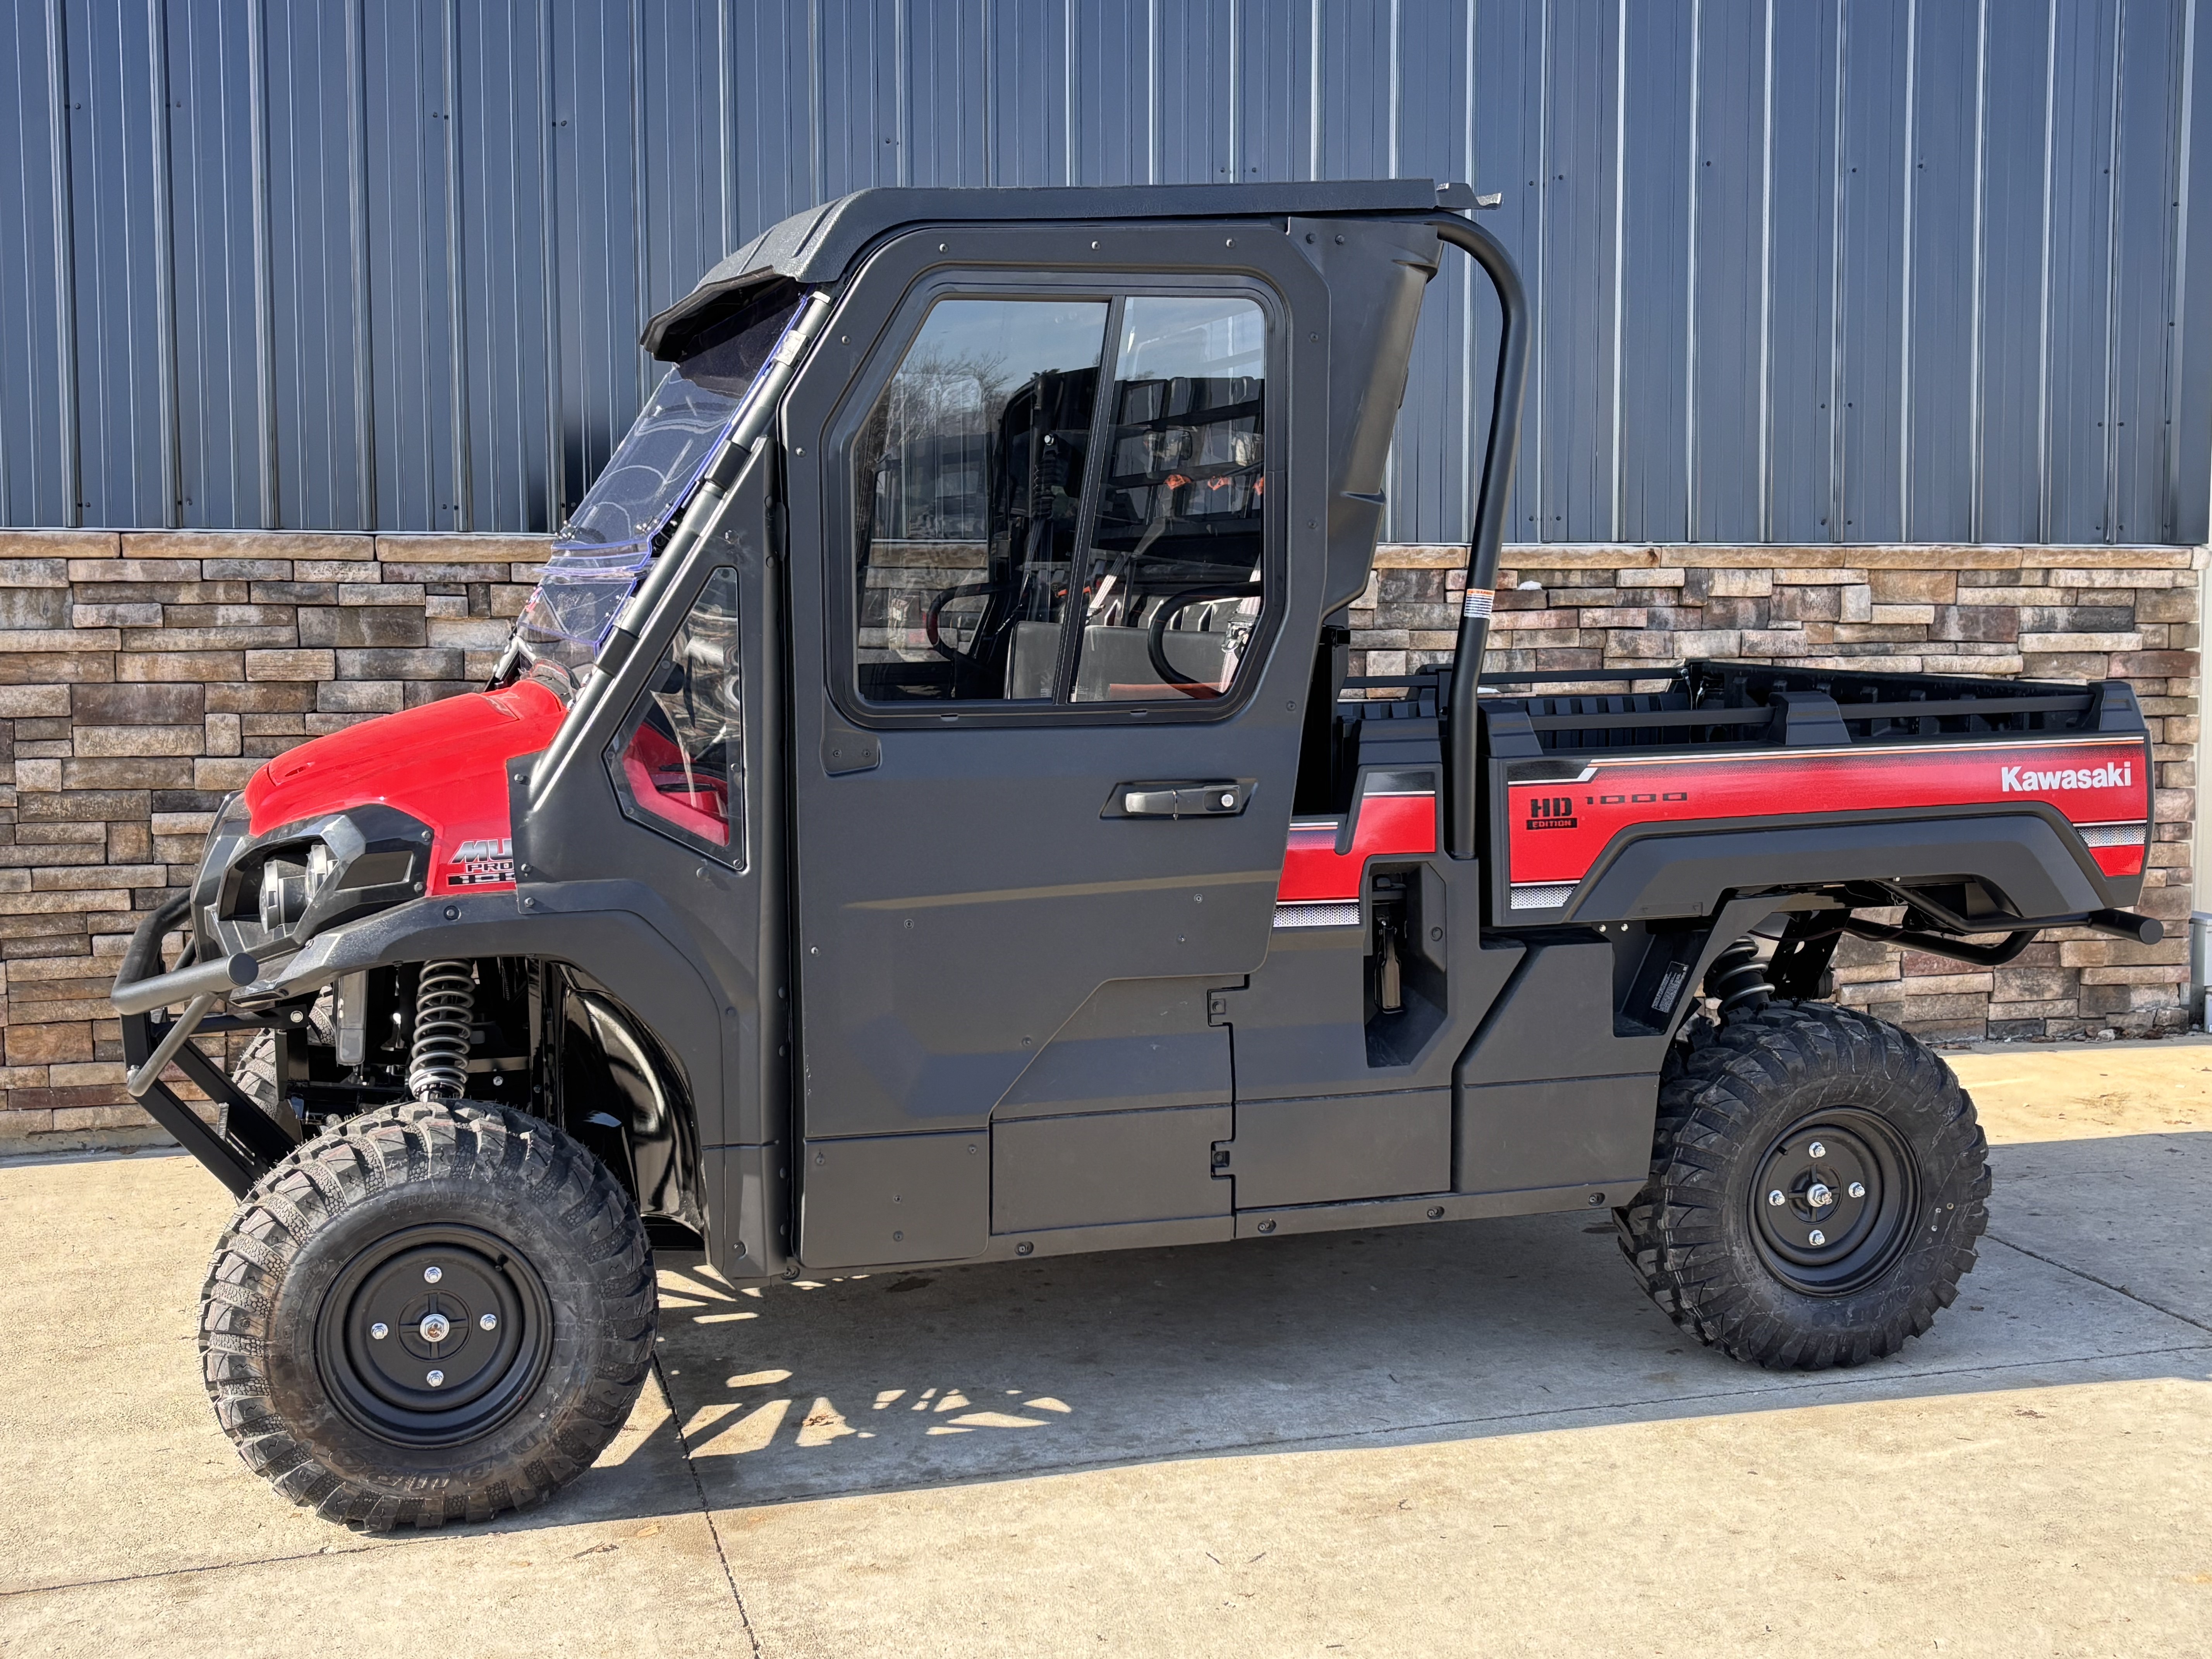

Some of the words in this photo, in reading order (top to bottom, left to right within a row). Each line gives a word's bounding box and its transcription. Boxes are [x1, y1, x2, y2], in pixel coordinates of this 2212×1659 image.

[2001, 761, 2131, 792] Kawasaki
[1530, 797, 1573, 818] HD
[1585, 792, 1687, 804] 1000
[1531, 820, 1572, 829] EDITION
